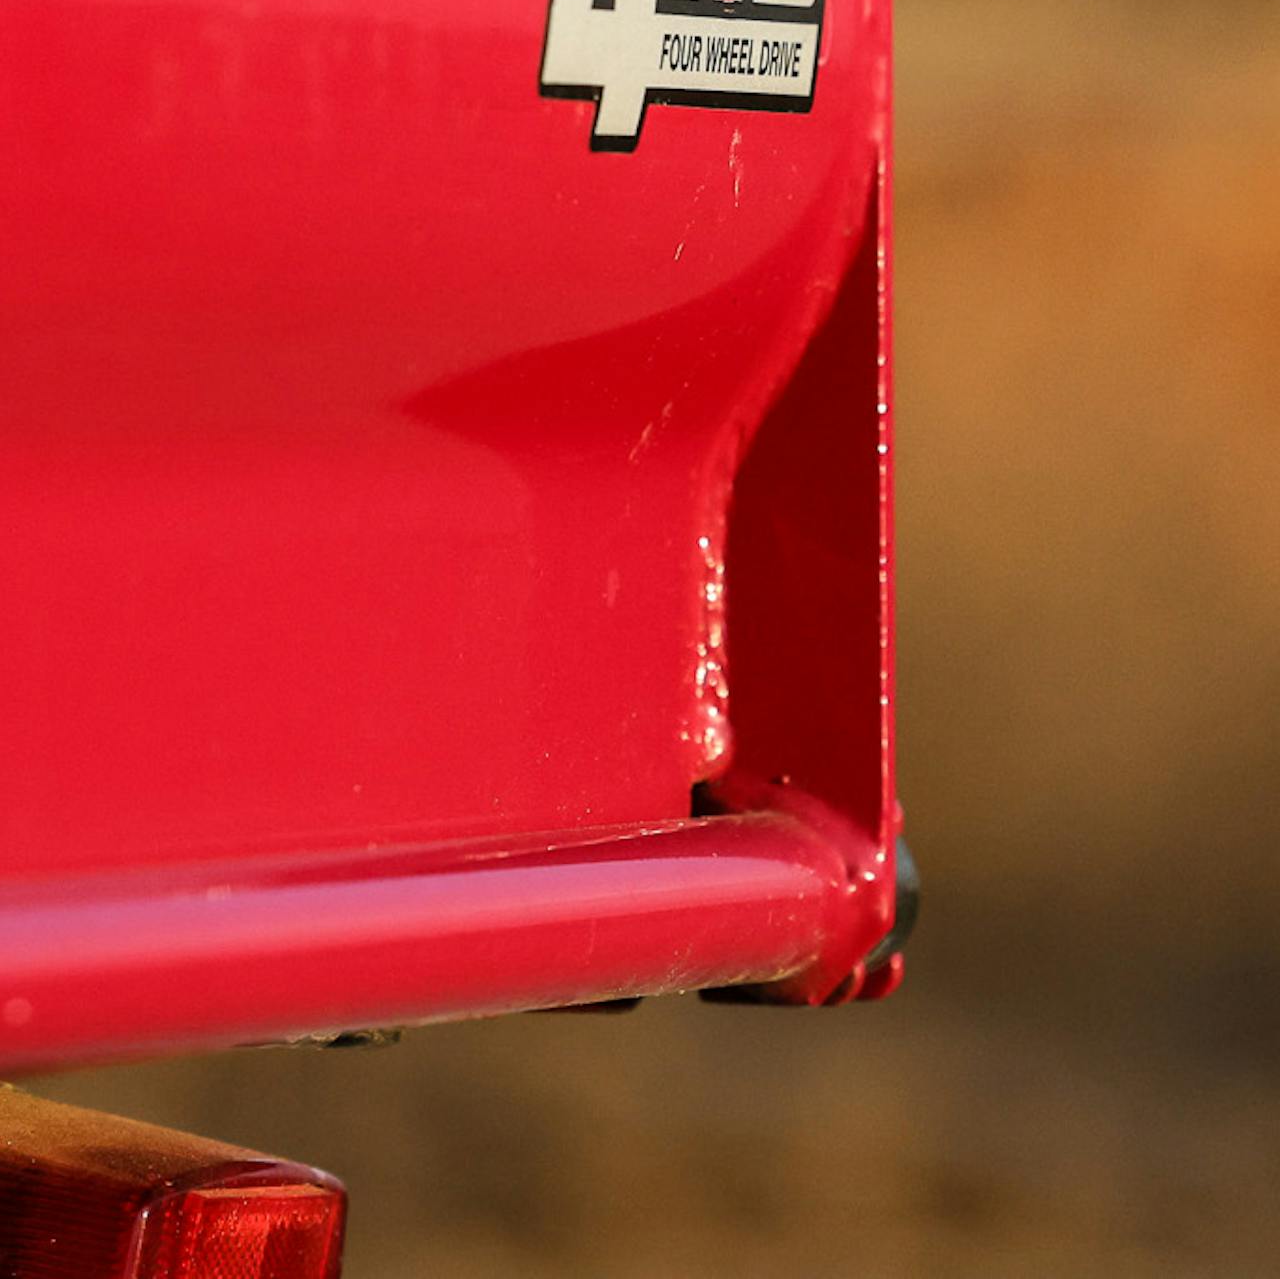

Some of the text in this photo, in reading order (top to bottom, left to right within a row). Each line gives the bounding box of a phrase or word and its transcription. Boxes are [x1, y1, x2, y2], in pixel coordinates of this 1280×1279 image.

[659, 33, 802, 77] FOUR WHEEL DRIVE
